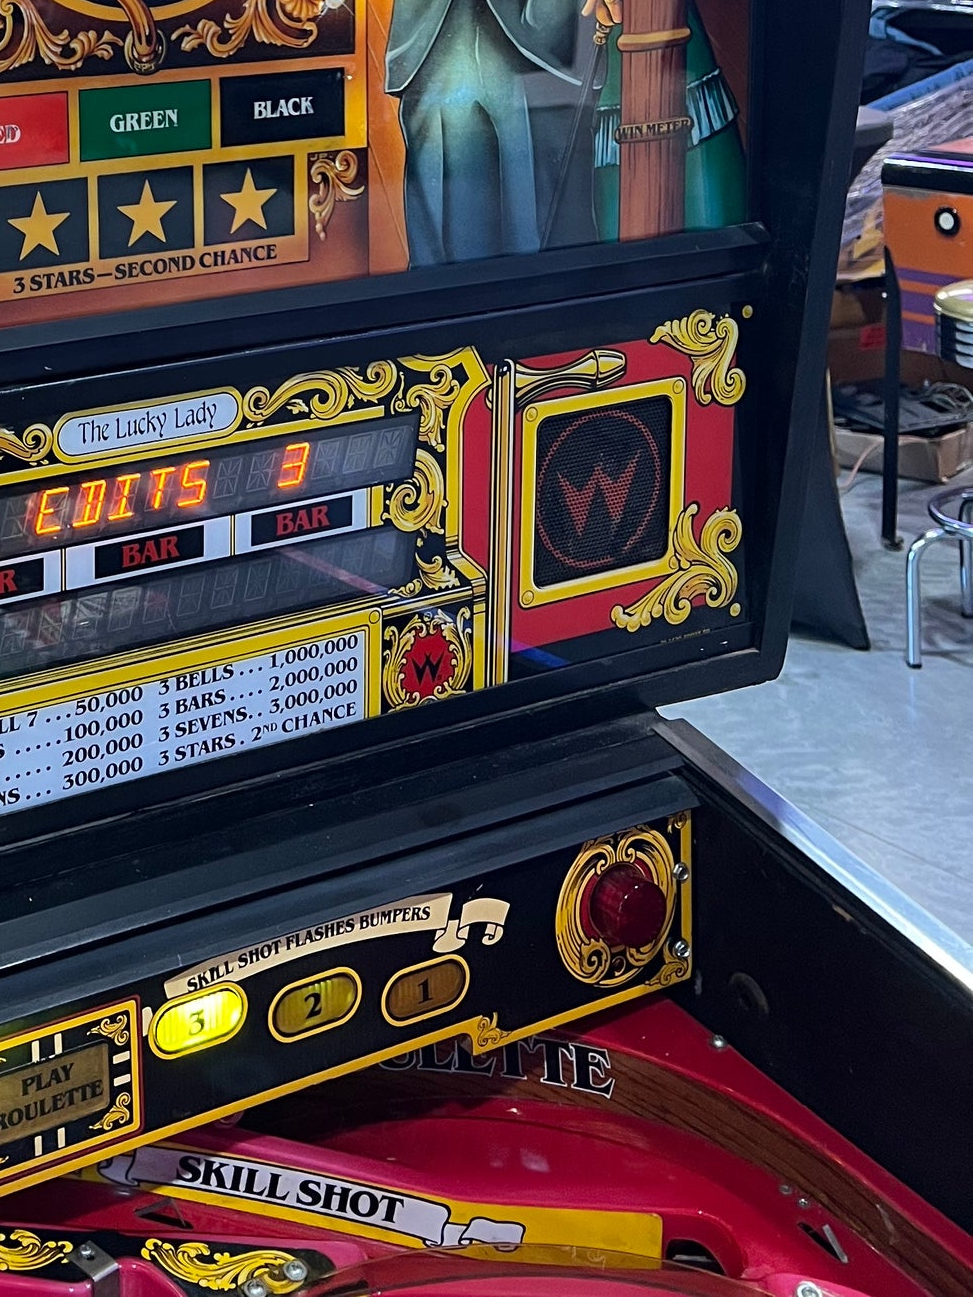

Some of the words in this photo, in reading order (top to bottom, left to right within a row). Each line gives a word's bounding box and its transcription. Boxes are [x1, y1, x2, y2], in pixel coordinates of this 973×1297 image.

[110, 108, 178, 133] GREEN
[253, 96, 315, 119] BLACK
[617, 124, 643, 141] WIN
[646, 118, 691, 136] METER
[13, 276, 26, 293] 3
[198, 244, 278, 269] CHANCE
[78, 419, 110, 445] The
[116, 411, 167, 438] Lucky
[175, 401, 217, 429] Lady
[35, 459, 211, 534] EDITS
[278, 442, 310, 488] 3
[276, 505, 330, 536] BAR
[122, 536, 179, 569] BAR
[158, 679, 170, 696] 3
[175, 663, 234, 692] BELLS
[269, 634, 358, 669] 1,000,000
[158, 702, 170, 719] 3
[175, 689, 226, 715] BARS
[269, 656, 358, 692] 2,000,000
[27, 710, 38, 728] 7
[74, 686, 143, 716] 50,000
[158, 726, 170, 742] 3
[175, 706, 248, 738] SEVENS
[269, 679, 358, 714] 3,000,000
[64, 709, 143, 743] 100,000
[158, 750, 170, 766] 3
[175, 733, 236, 762] STARS
[251, 722, 278, 743] 2ND
[281, 701, 357, 733] CHANCE
[62, 733, 143, 768] 200,000
[62, 756, 143, 790] 300,000
[186, 961, 234, 993] SKILL
[237, 939, 282, 969] SHOT
[285, 920, 355, 951] FLASHES
[359, 905, 431, 930] BUMPERS
[303, 992, 322, 1020] 2
[417, 978, 433, 1003] 1
[186, 1007, 207, 1035] 3
[21, 1062, 75, 1097] PLAY
[176, 1155, 290, 1199] SKILL
[296, 1180, 405, 1224] SHOT
